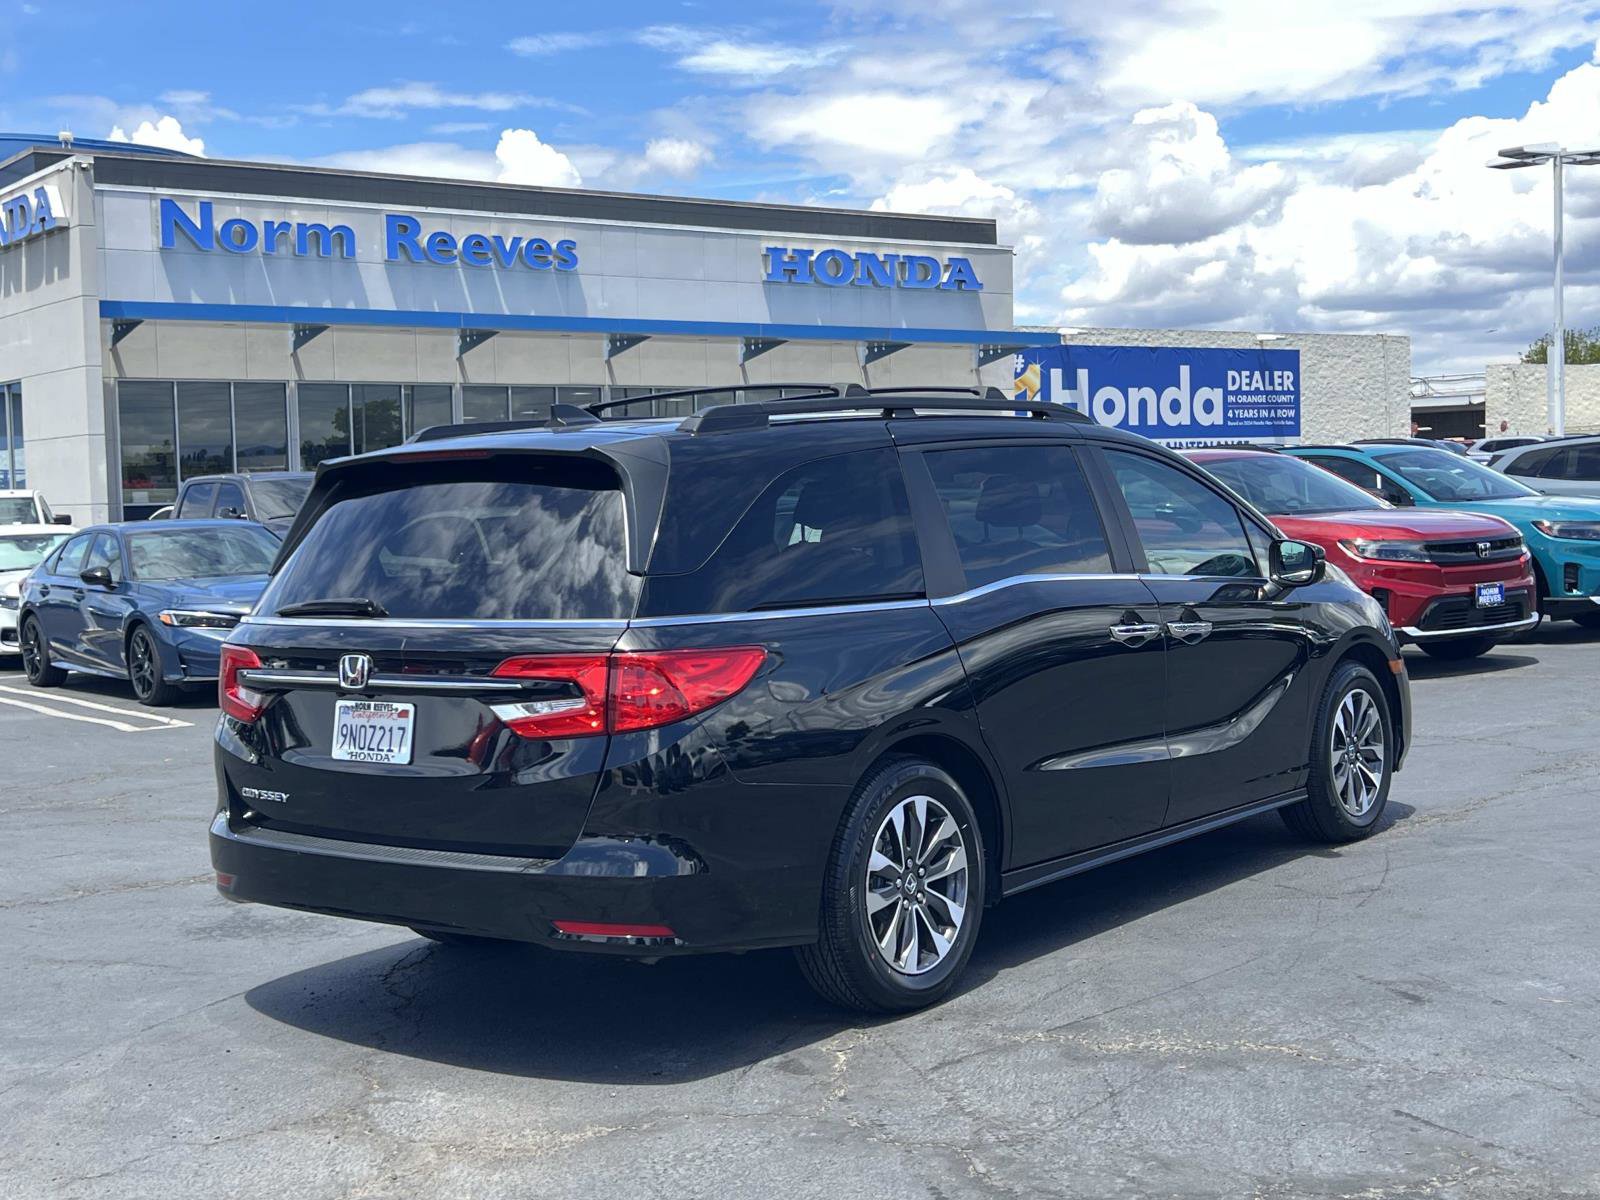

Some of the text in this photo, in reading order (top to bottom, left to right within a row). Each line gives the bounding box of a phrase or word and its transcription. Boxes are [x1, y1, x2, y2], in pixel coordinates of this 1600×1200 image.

[160, 198, 580, 272] Norm Reeves
[762, 246, 984, 291] HONDA
[1227, 370, 1295, 391] DEALER
[1050, 364, 1224, 428] Honda
[1227, 394, 1295, 403] IN ORANGE COUNTY
[1227, 409, 1296, 418] 4 YEARS IN A ROW
[350, 751, 391, 762] HONDA
[241, 787, 290, 803] ODYSSEY
